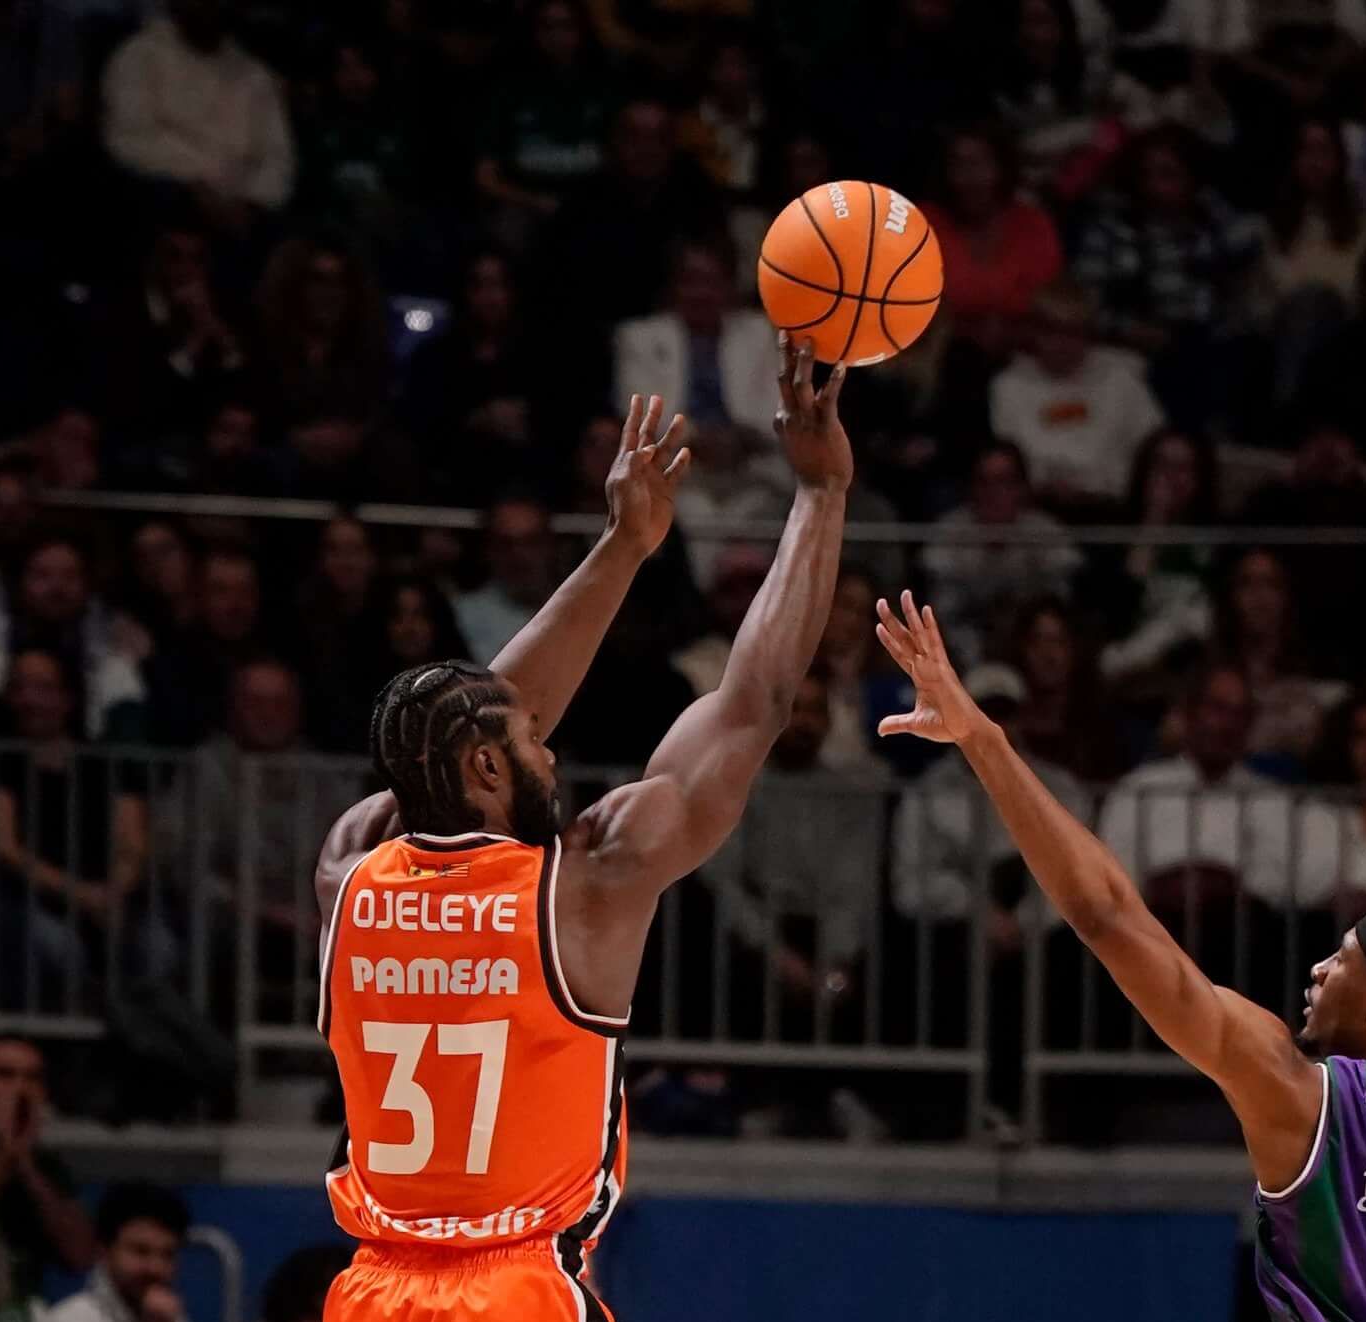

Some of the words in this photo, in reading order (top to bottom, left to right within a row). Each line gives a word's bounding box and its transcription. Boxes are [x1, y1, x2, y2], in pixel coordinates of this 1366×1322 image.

[352, 889, 518, 932] OJELEYE
[351, 957, 518, 995] PAMESA
[362, 1019, 510, 1175] 37
